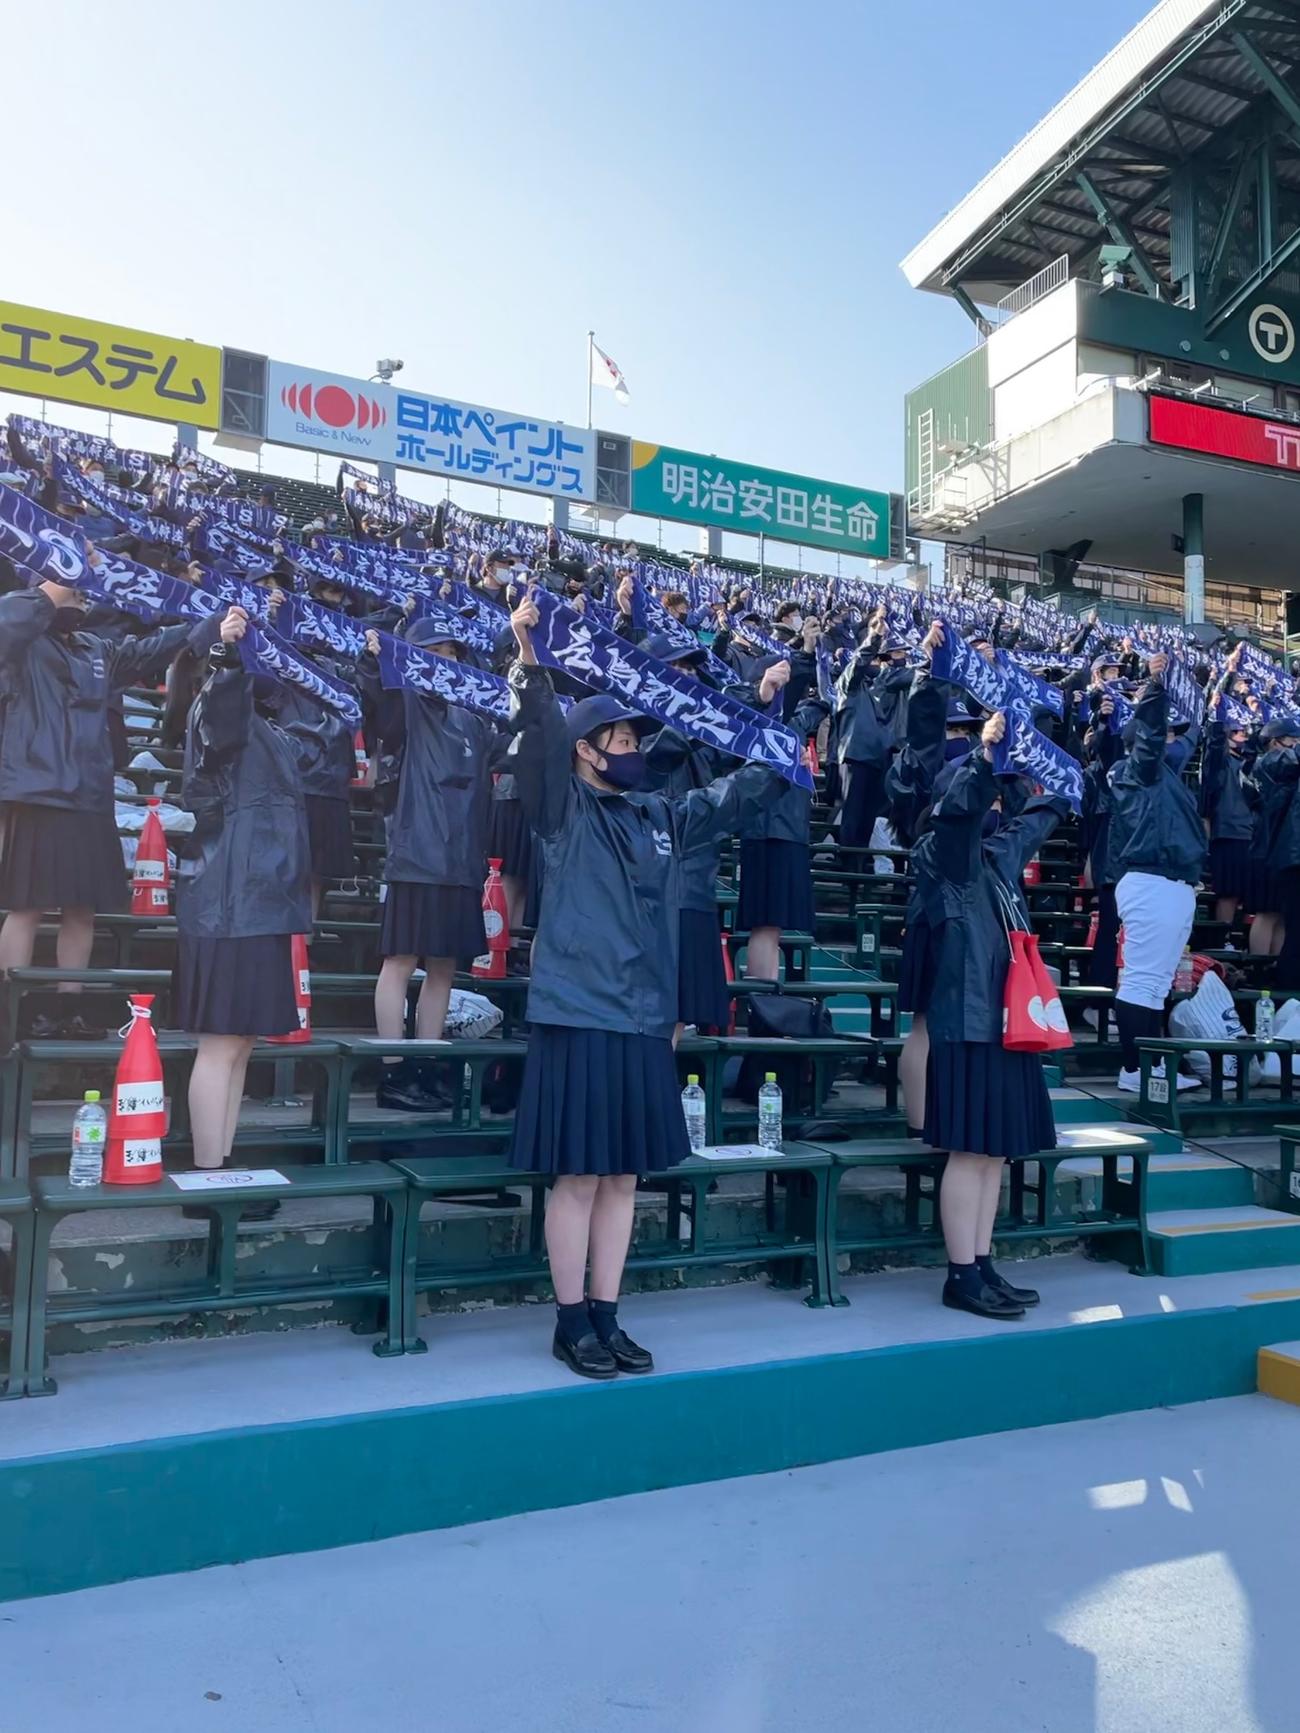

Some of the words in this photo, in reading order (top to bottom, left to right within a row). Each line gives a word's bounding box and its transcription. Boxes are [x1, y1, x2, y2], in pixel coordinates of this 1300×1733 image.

[0, 322, 206, 404] エステム
[296, 422, 329, 439] Basic
[331, 430, 339, 440] &
[341, 430, 373, 447] New
[396, 394, 584, 460] 日本ペイント
[396, 433, 583, 494] ホールディングス
[662, 461, 879, 542] 明治安田生命
